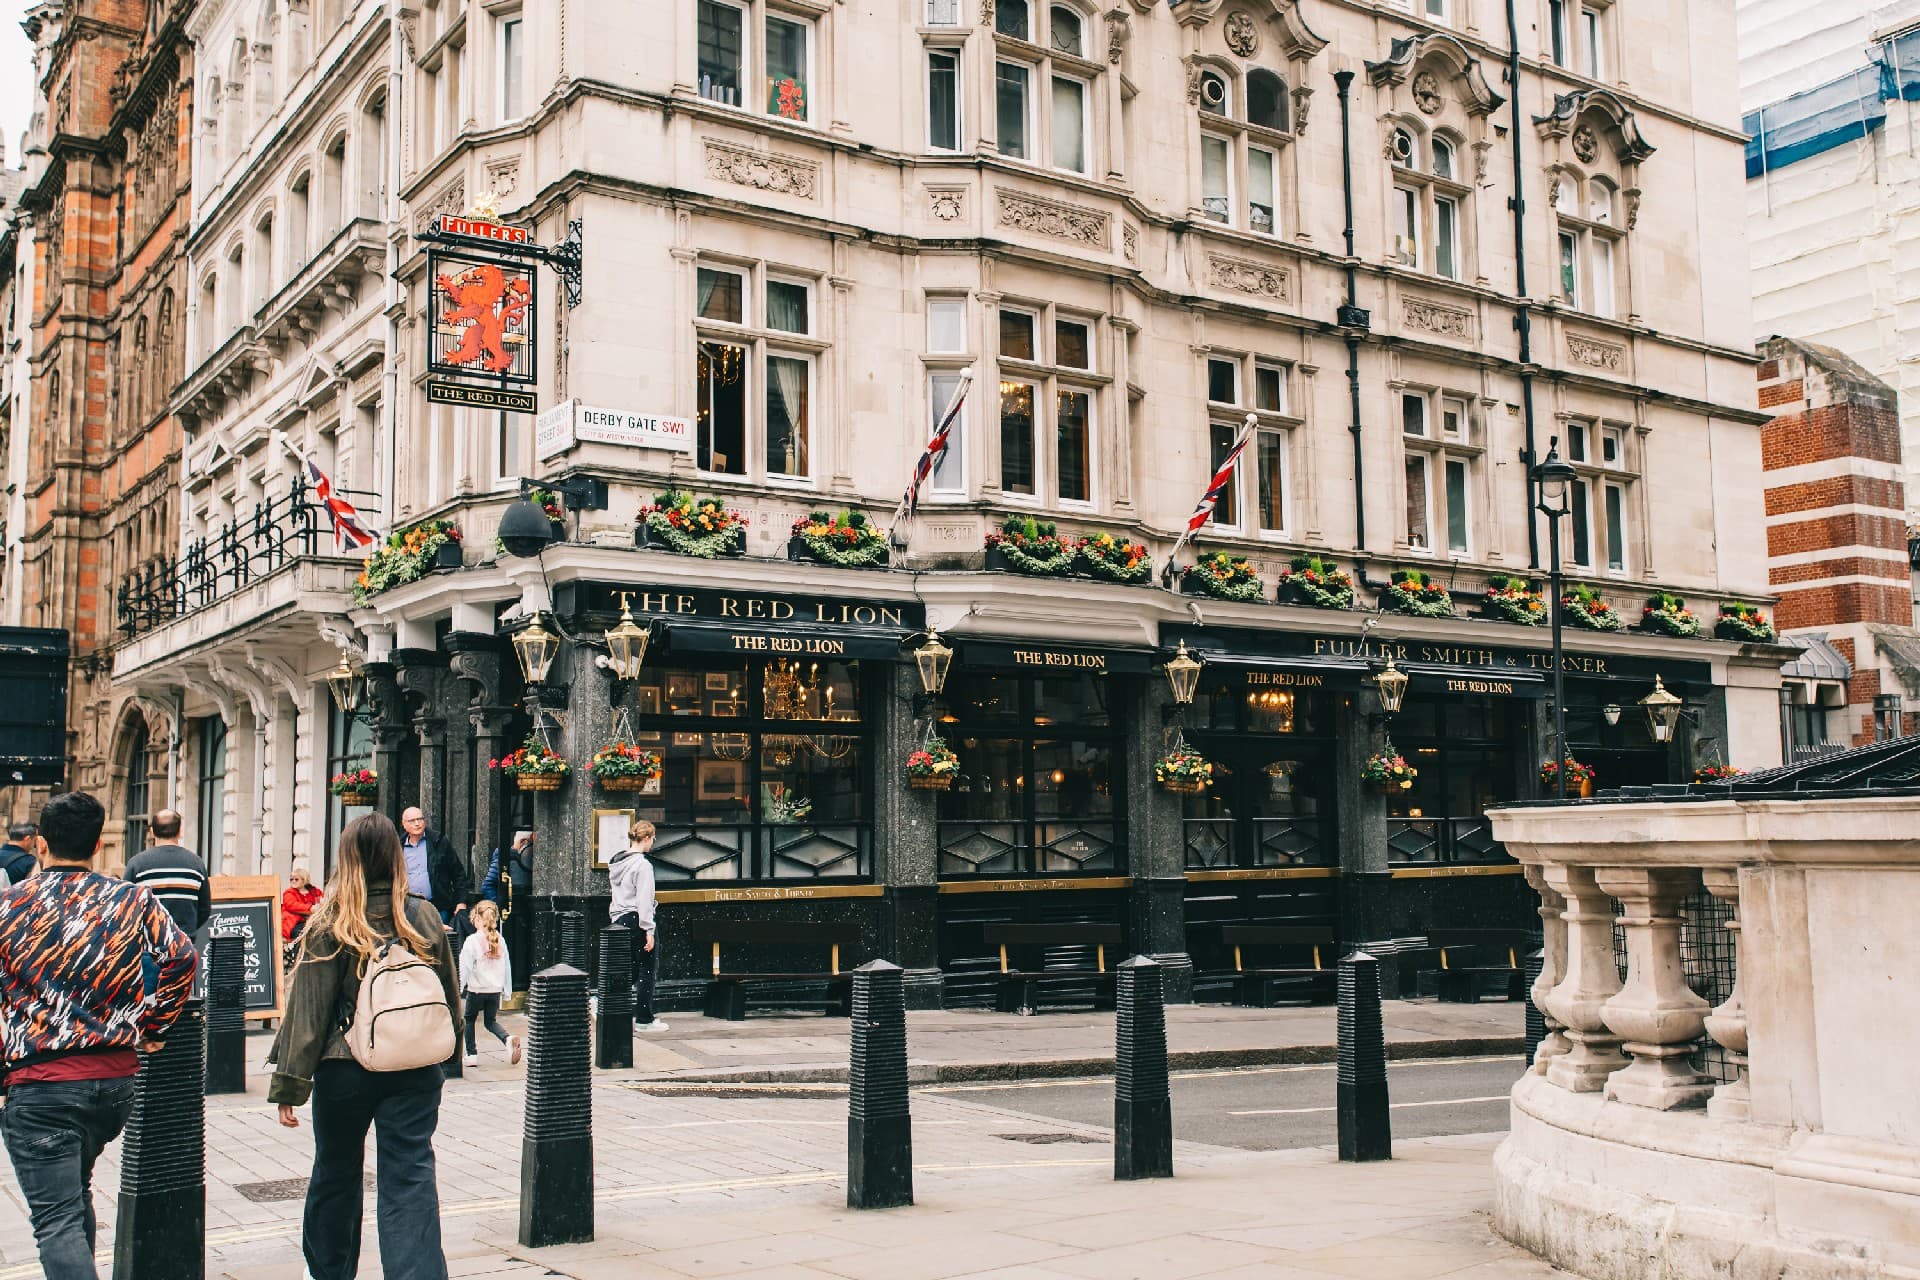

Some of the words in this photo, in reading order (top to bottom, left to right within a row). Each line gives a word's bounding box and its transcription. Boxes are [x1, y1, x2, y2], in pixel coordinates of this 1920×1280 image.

[446, 217, 522, 242] FULLER'S
[433, 387, 464, 400] THE
[467, 391, 494, 403] RED
[498, 394, 530, 407] LION
[584, 411, 623, 426] DERBY
[628, 416, 657, 432] GATE
[662, 421, 685, 435] SW1
[610, 590, 697, 614] THE
[719, 597, 794, 619] RED
[816, 603, 902, 625] LION
[731, 635, 768, 650] THE
[769, 637, 803, 652] RED
[805, 639, 844, 654] LION
[1314, 639, 1408, 660] FULLER
[1422, 647, 1493, 665] SMITH
[1505, 655, 1516, 667] &
[1013, 650, 1043, 664] THE
[1044, 652, 1072, 666] RED
[1073, 654, 1105, 668] LION
[1246, 671, 1271, 684] THE
[1272, 673, 1294, 685] RED
[1296, 674, 1323, 686] LION
[1446, 680, 1468, 691] THE
[1468, 681, 1488, 692] RED
[1488, 682, 1513, 694] LION
